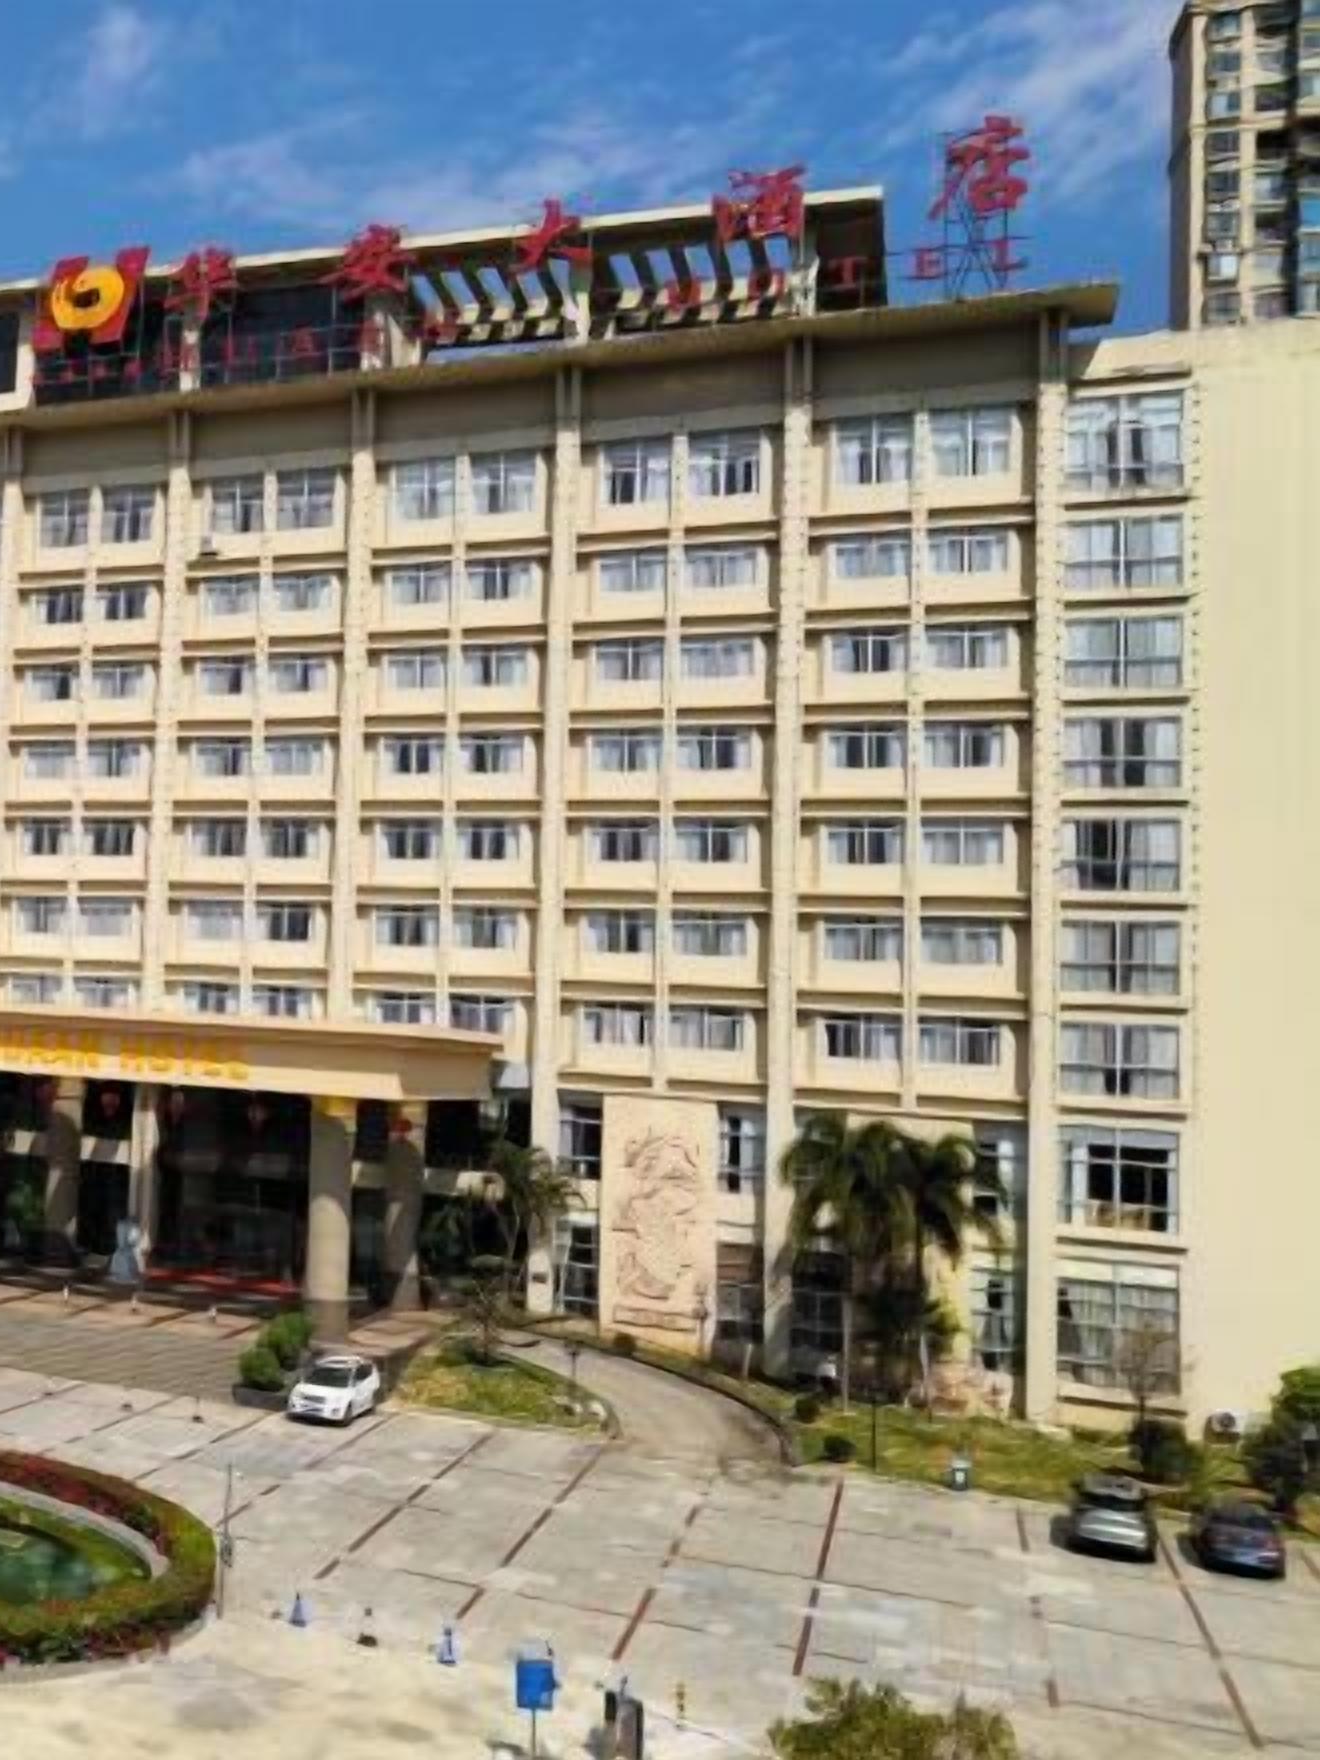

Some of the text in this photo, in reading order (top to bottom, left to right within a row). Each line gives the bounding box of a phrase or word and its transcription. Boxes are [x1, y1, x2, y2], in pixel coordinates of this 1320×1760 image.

[164, 114, 1031, 322] 华安大酒店
[120, 1033, 249, 1081] HOTEL
